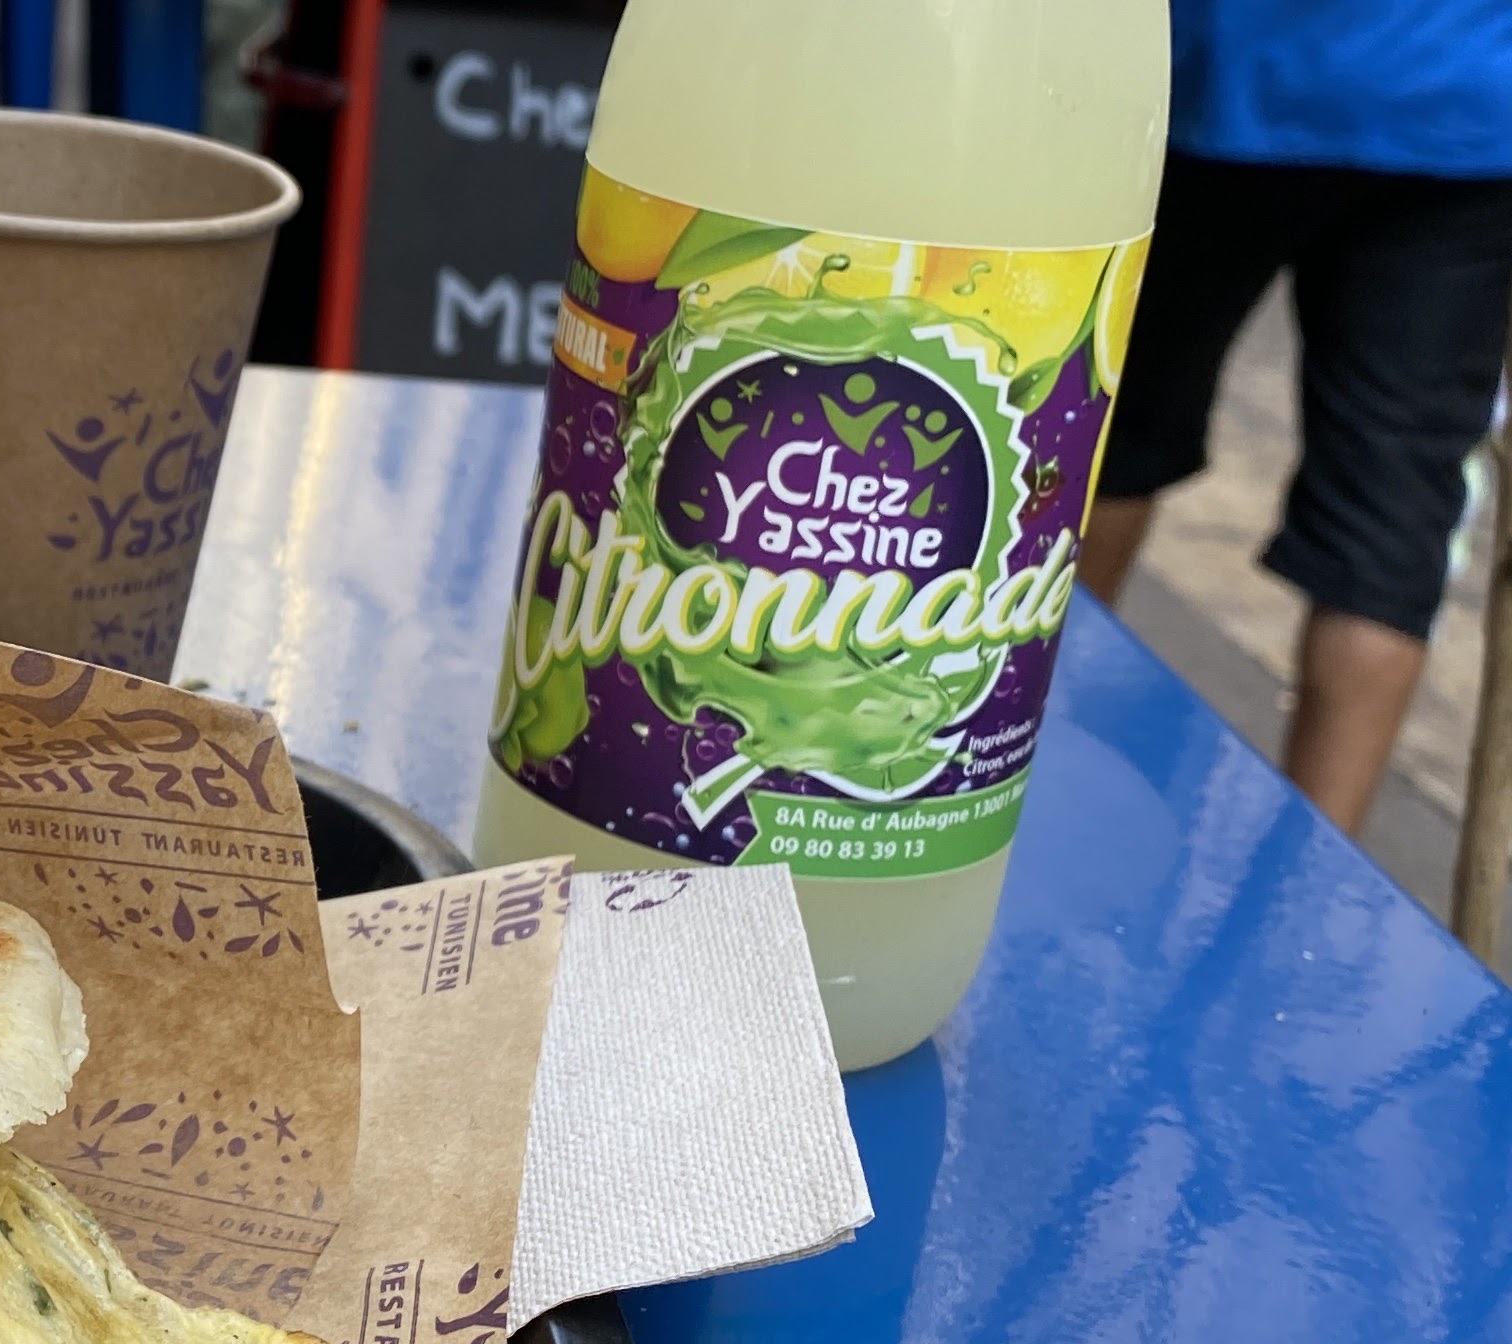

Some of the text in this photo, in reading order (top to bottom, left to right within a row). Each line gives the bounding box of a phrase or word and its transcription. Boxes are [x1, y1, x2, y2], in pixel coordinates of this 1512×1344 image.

[714, 470, 943, 568] Yassine
[766, 438, 909, 517] Chez
[512, 488, 1078, 688] Citronnade
[770, 836, 926, 860] 09 80 83 39 13
[774, 807, 805, 828] 8A
[812, 809, 856, 831] Rue
[885, 808, 969, 833] Aubagne
[435, 892, 472, 993] TUNISIEN
